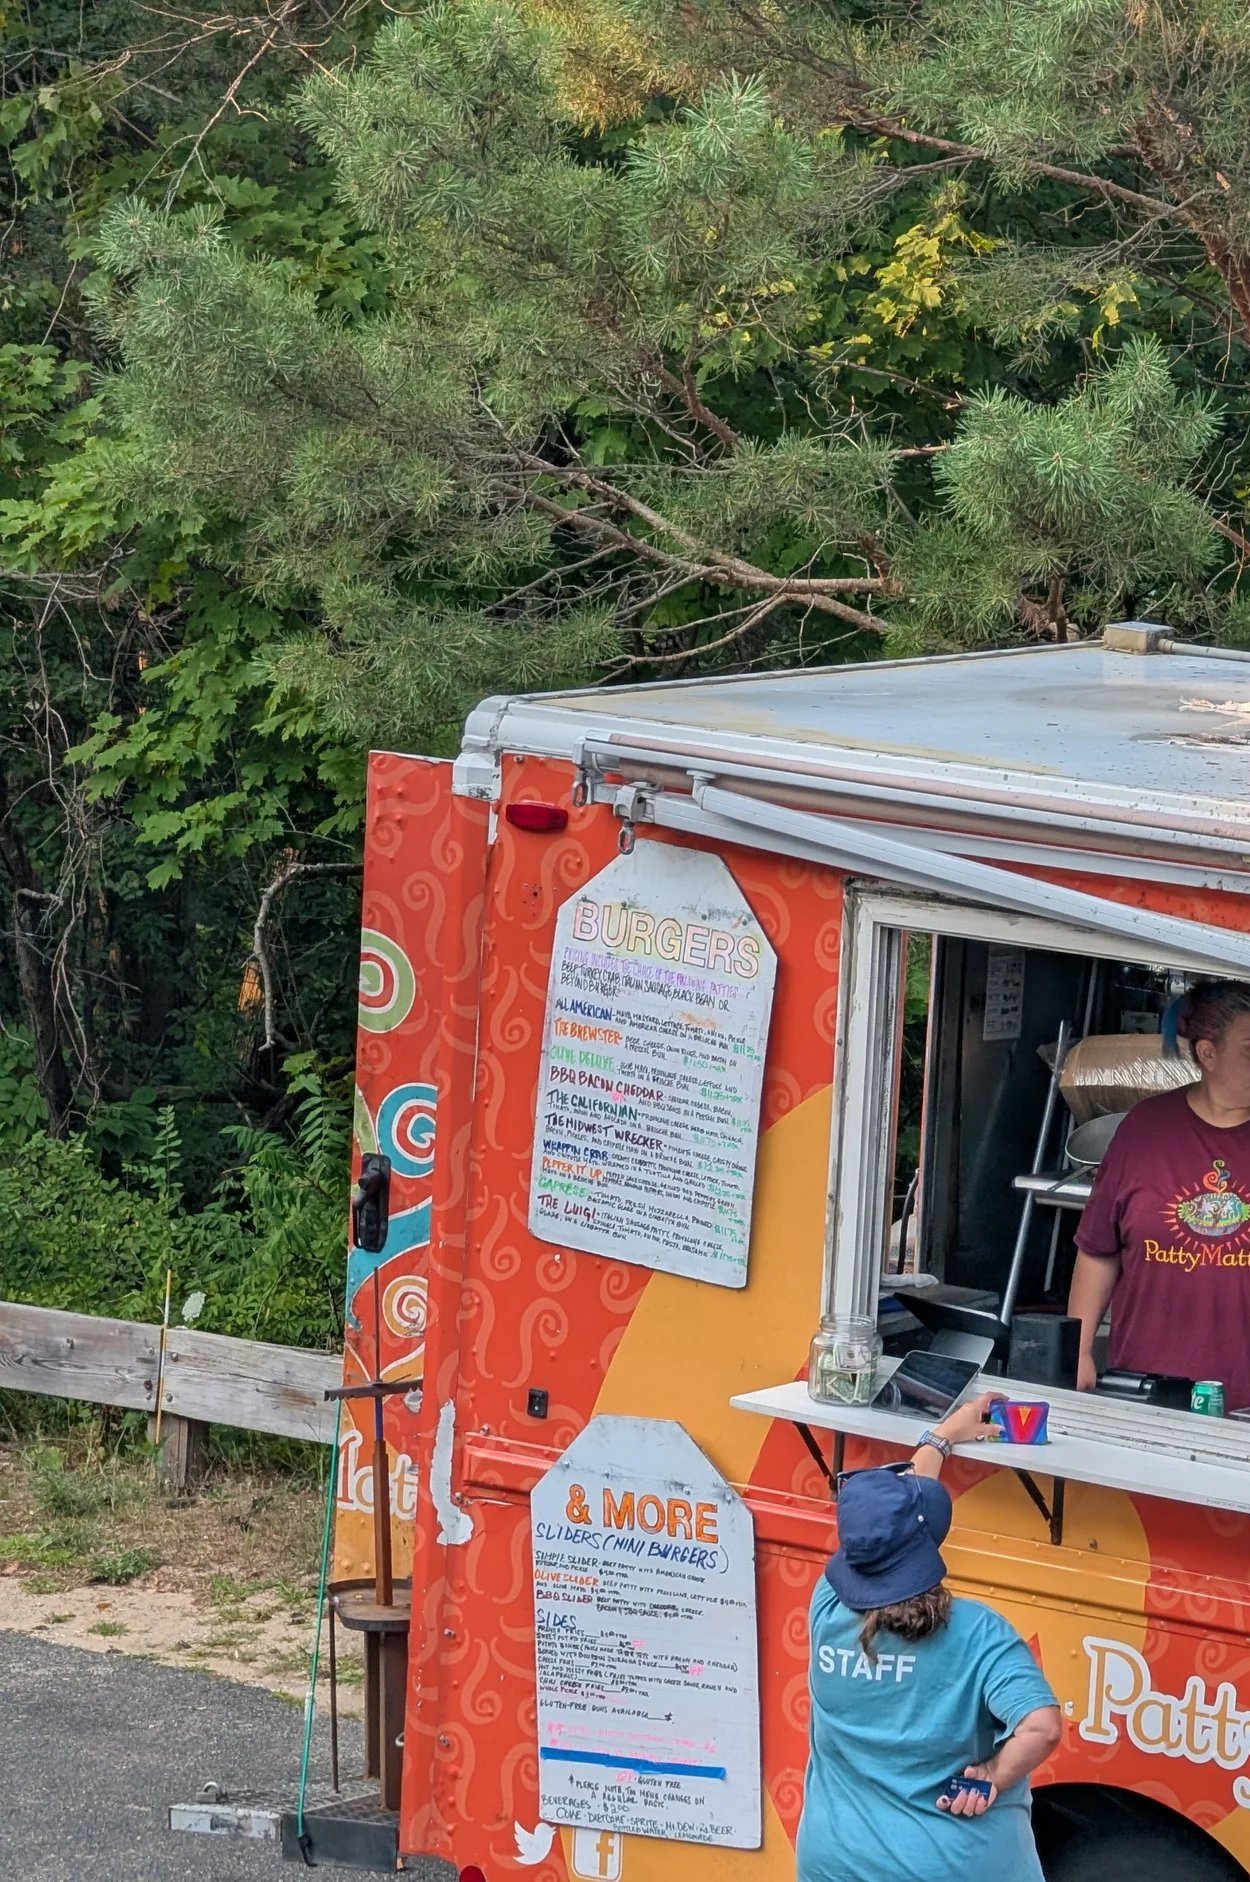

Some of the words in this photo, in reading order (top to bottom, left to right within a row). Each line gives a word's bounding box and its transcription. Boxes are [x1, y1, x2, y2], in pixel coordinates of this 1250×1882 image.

[573, 900, 760, 978] BURGERS
[561, 973, 587, 990] BEYOND
[719, 1000, 730, 1011] OR
[550, 1066, 576, 1084] BBQ
[579, 1071, 613, 1092] BACON
[616, 1081, 663, 1101] CHEDDAR
[546, 1089, 568, 1107] THE
[571, 1095, 638, 1120] CALIFORNIAN
[544, 1113, 564, 1126] THE
[566, 1118, 614, 1136] MIDWEST
[615, 1130, 665, 1151] WRECKER
[584, 1147, 610, 1163] CRAB
[542, 1157, 574, 1175] PEPPER
[576, 1160, 587, 1174] IT
[590, 1169, 604, 1181] UP
[538, 1176, 589, 1200] CAPRESE
[537, 1194, 558, 1209] THE
[564, 1201, 596, 1223] LUIGI
[566, 1484, 592, 1525] &
[602, 1488, 719, 1544] MORE
[536, 1523, 602, 1549] SLIDERS
[603, 1535, 645, 1556] (MINI
[648, 1542, 728, 1573] BURGERS)
[534, 1569, 561, 1582] OLIVE
[564, 1574, 599, 1586] SLIDER
[536, 1590, 560, 1600] BBQ
[535, 1609, 577, 1631] SIDES
[818, 1645, 916, 1683] STAFF
[540, 1795, 591, 1809] BEVERAGES
[695, 1797, 704, 1805] ON
